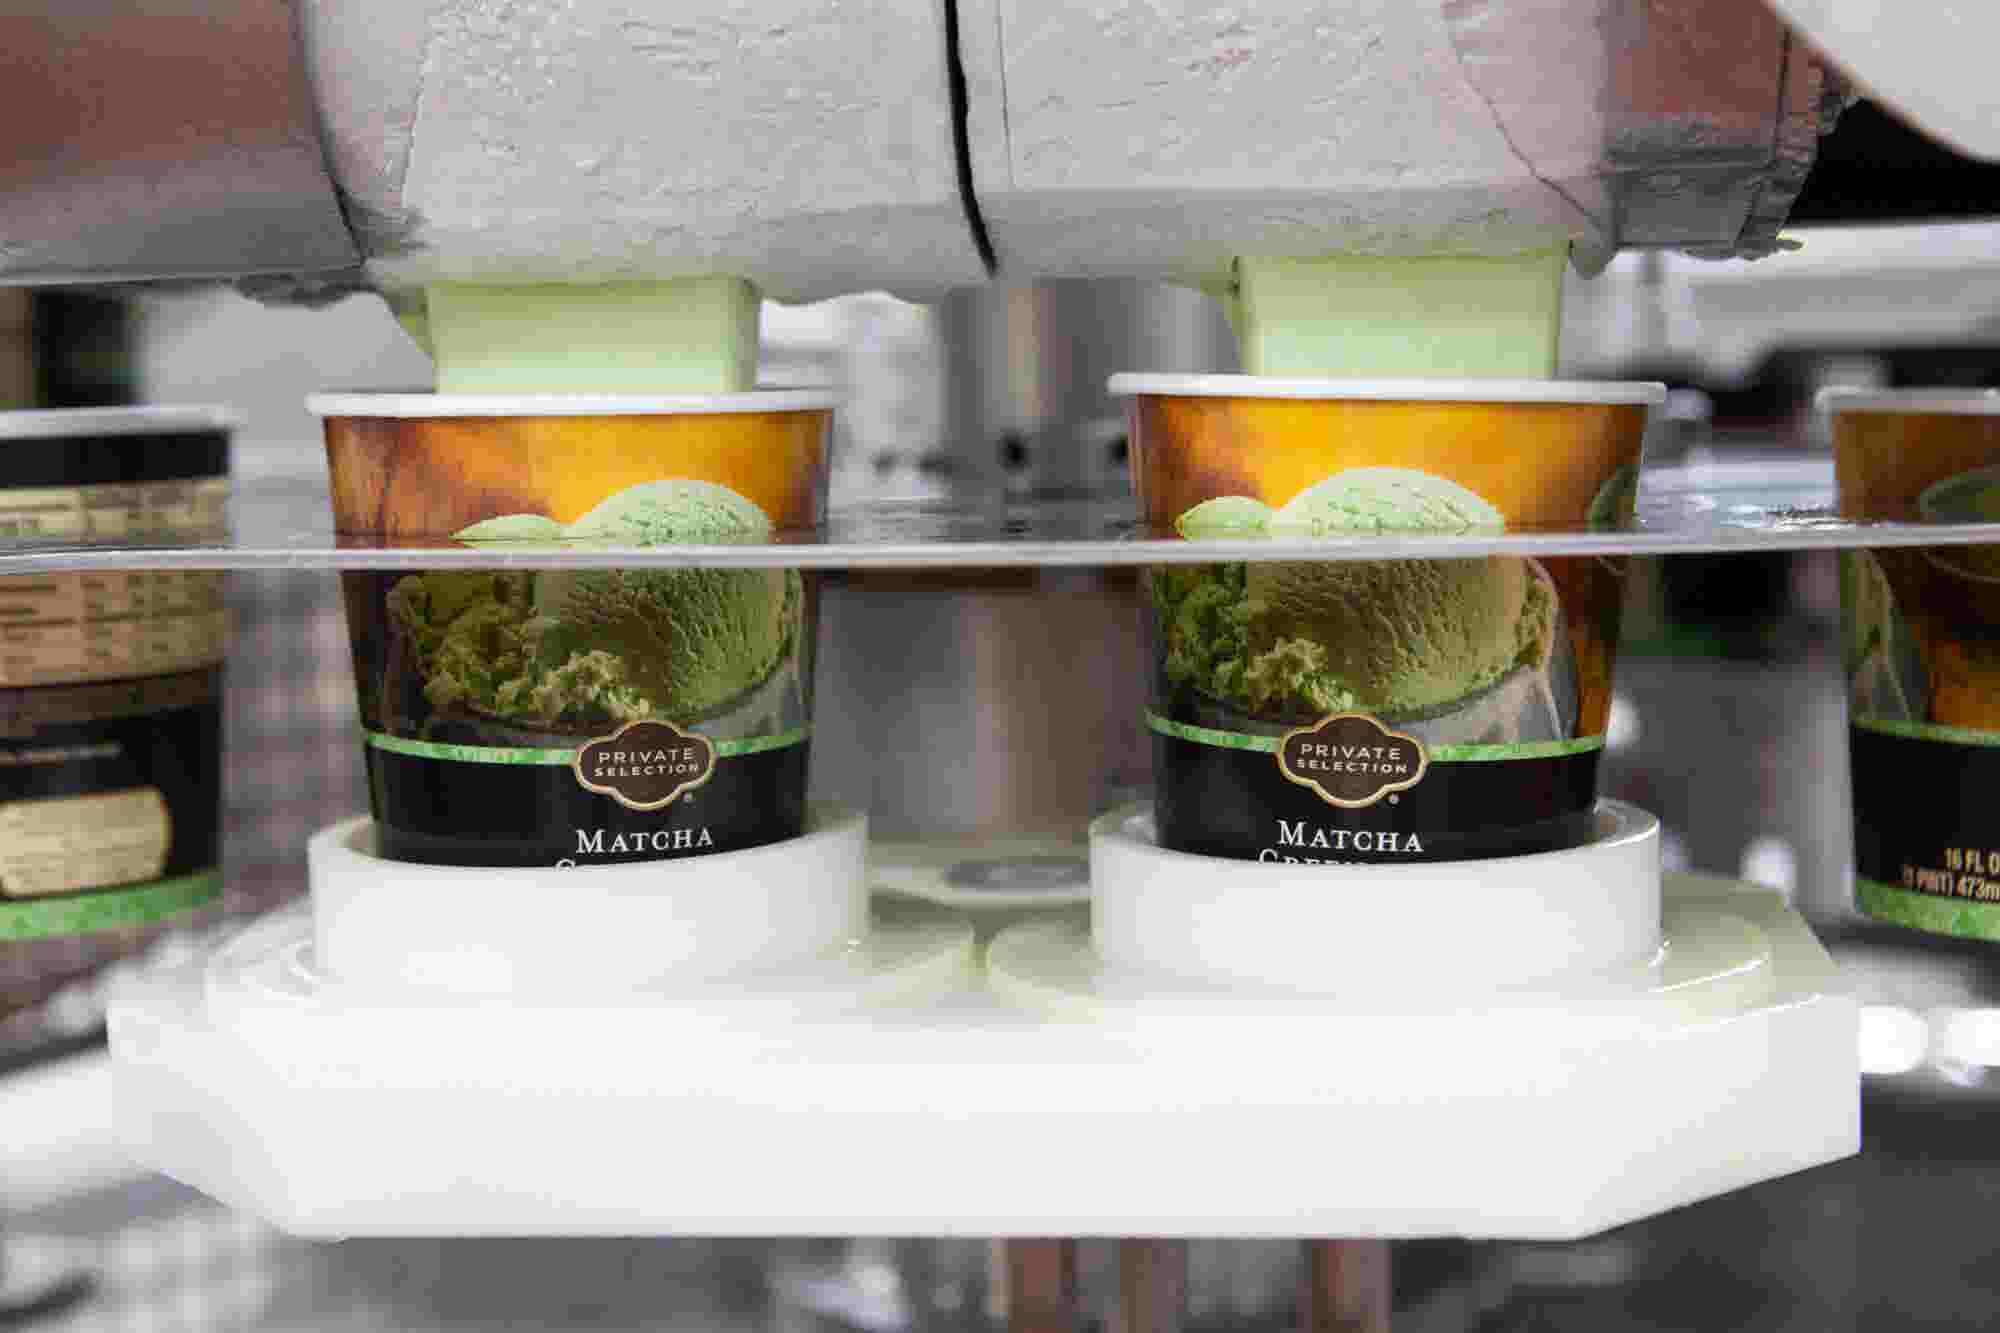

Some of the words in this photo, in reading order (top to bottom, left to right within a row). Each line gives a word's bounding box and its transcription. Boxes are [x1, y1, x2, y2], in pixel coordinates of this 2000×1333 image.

[598, 747, 697, 765] PRIVATE
[1300, 743, 1401, 761] PRIVATE
[593, 762, 700, 777] SELECTION
[1295, 759, 1408, 774] SELECTION
[575, 826, 713, 854] MATCHA
[1275, 819, 1424, 853] MATCHA
[1964, 848, 1984, 872] FL
